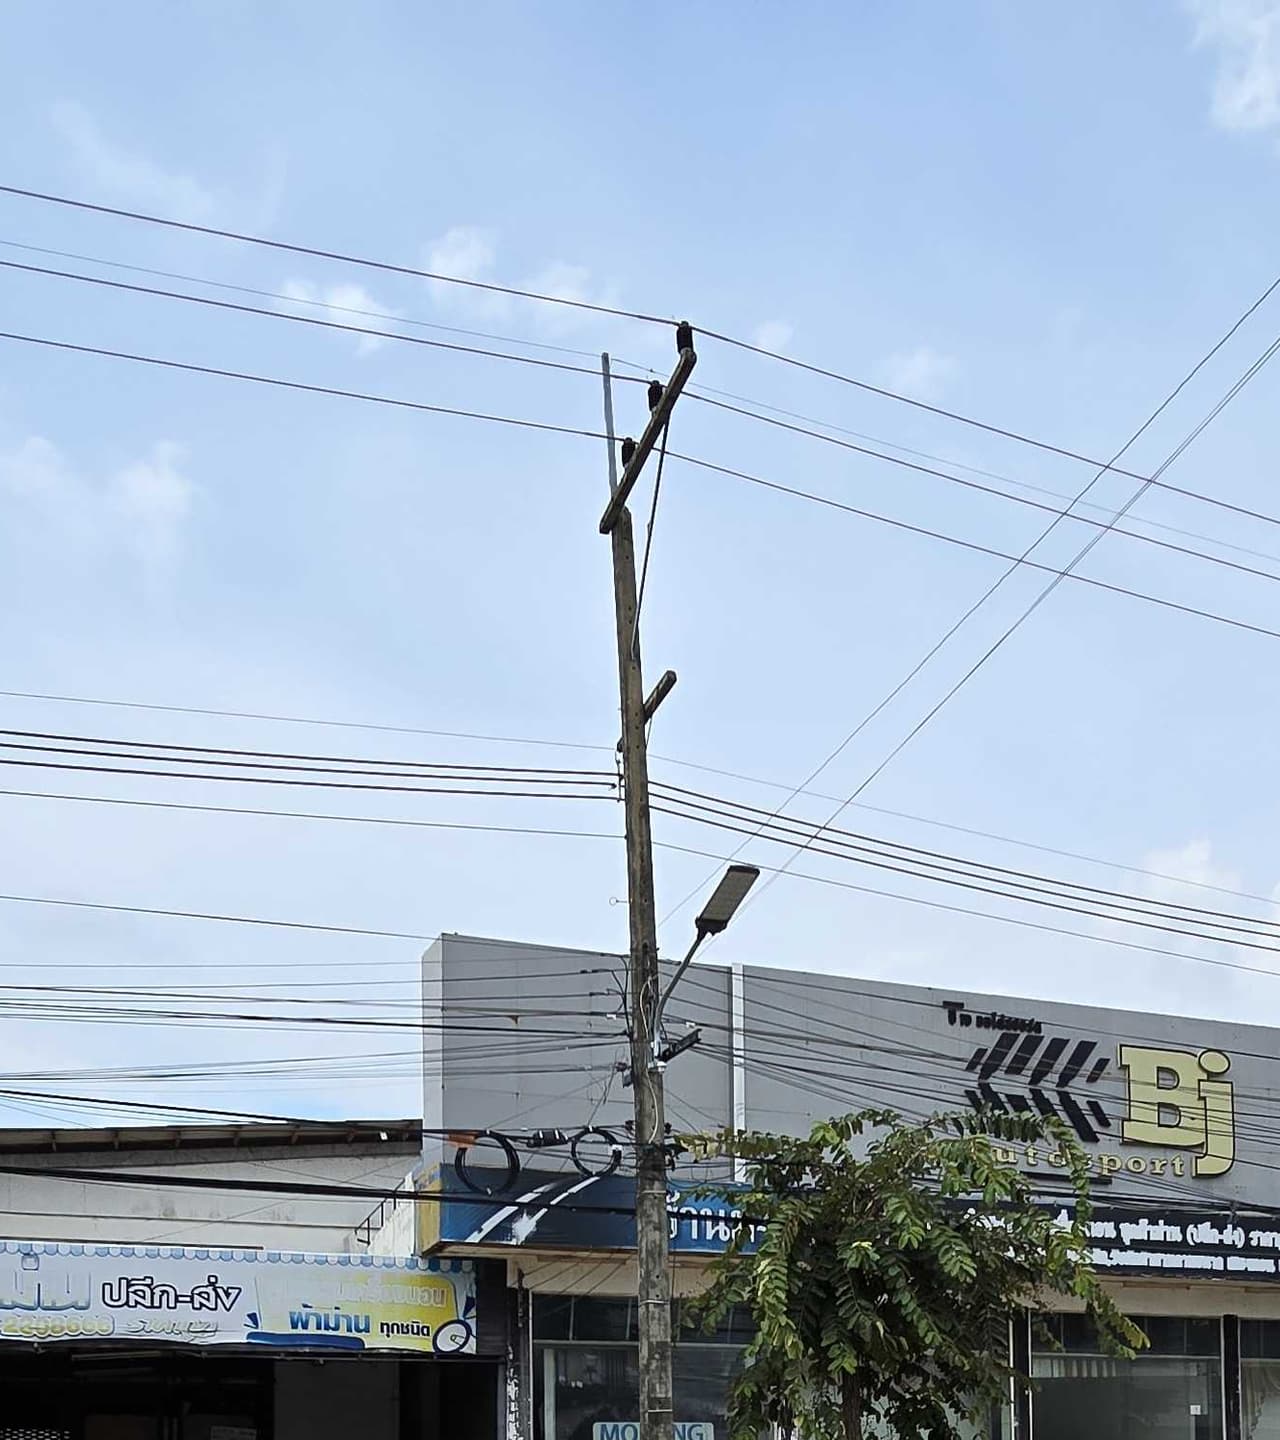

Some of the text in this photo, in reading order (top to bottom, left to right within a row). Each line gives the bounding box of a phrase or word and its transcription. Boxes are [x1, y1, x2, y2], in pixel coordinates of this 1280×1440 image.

[102, 1275, 242, 1311] ปลีก-ส่ง
[288, 1303, 431, 1338] ผ้าม่าน ทุกชนิด
